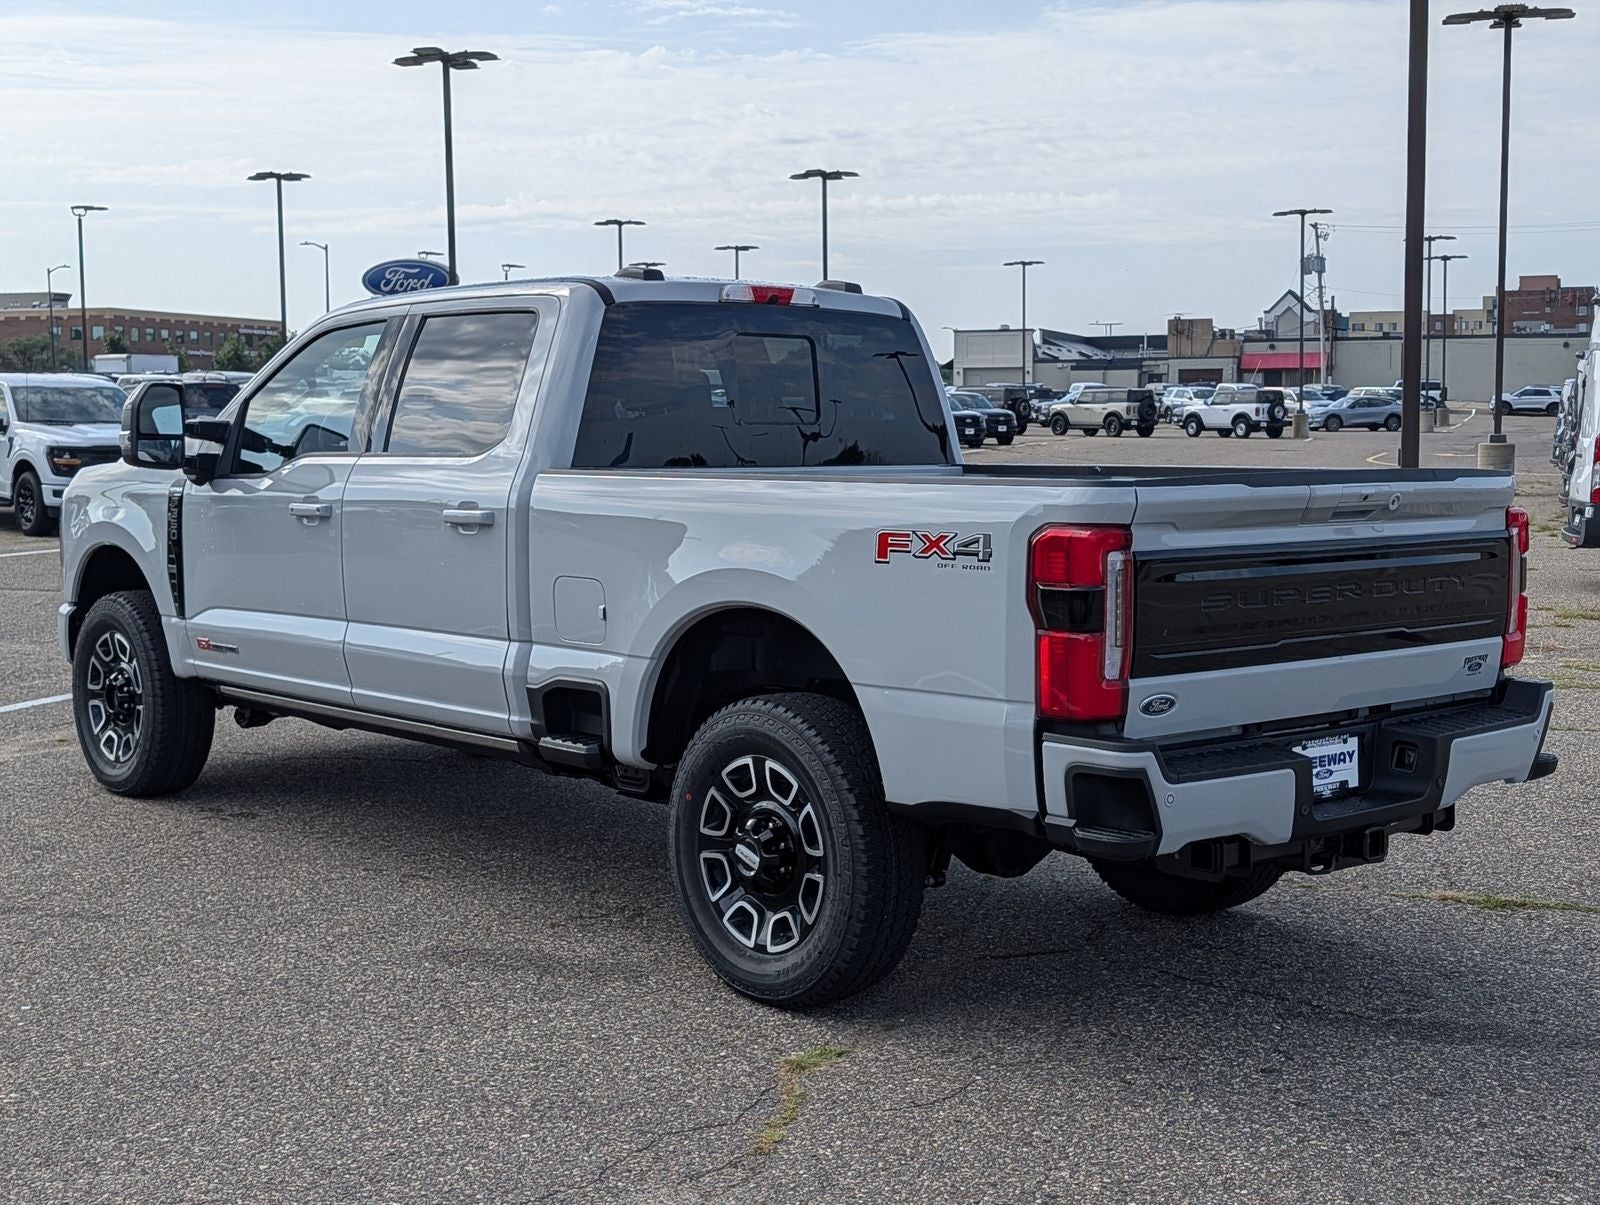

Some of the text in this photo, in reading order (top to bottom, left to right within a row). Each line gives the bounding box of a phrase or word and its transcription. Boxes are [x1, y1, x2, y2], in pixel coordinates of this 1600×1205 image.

[380, 266, 434, 292] Ford
[874, 529, 992, 564] FX4
[961, 564, 991, 572] ROAD
[1200, 575, 1466, 613] SUPER DUTY
[1312, 750, 1356, 769] EEWAY
